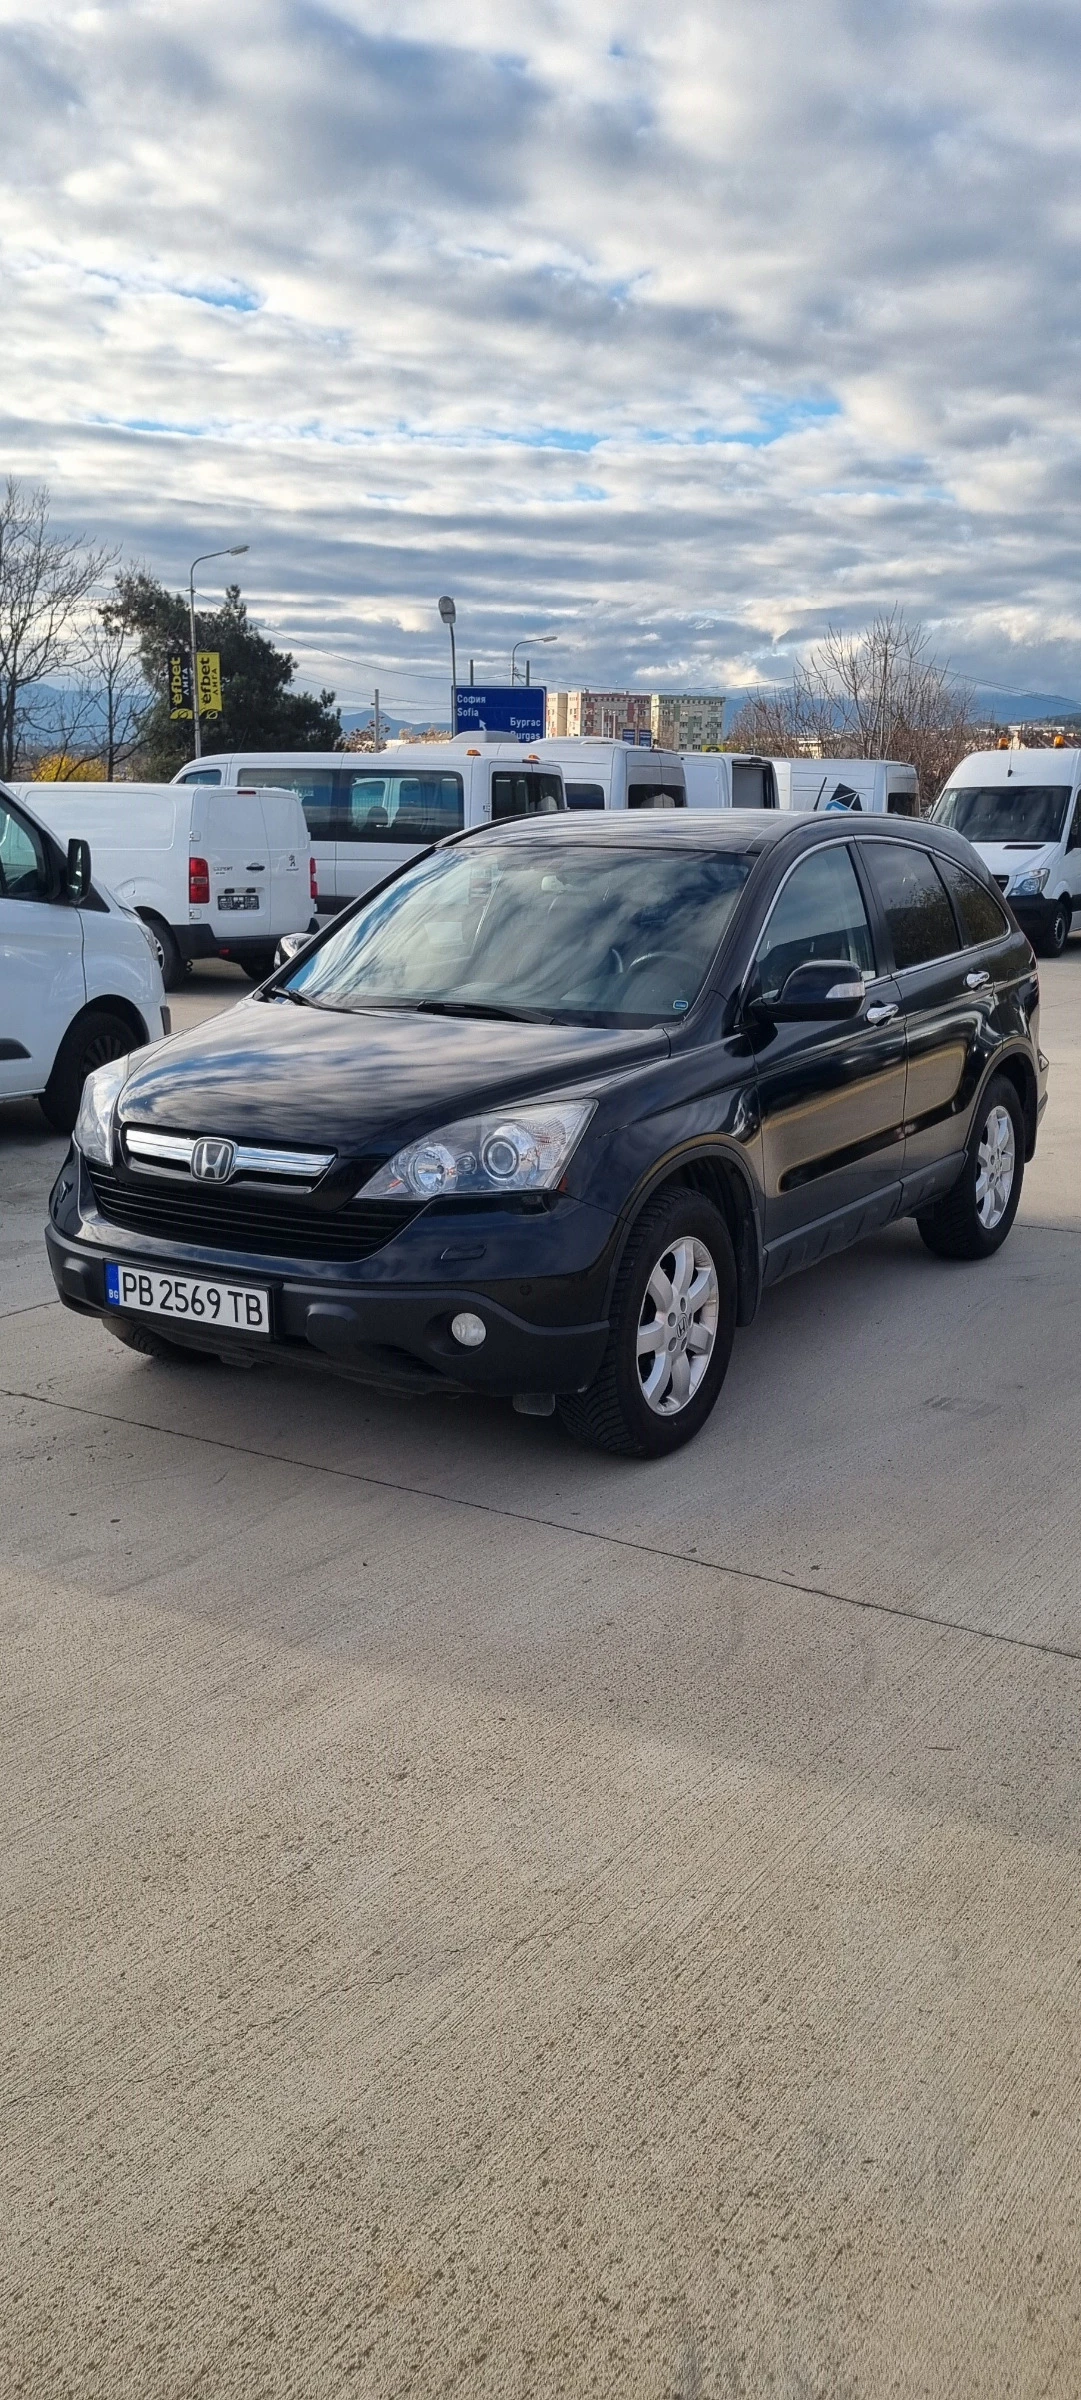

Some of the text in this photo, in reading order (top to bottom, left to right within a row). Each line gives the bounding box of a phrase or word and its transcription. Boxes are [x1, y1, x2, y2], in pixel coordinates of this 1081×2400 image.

[170, 656, 183, 705] efbet
[199, 656, 212, 705] efbet
[456, 694, 486, 704] София
[457, 707, 479, 717] Sofia
[509, 717, 541, 728] Бургас
[108, 1288, 119, 1300] BG
[122, 1271, 263, 1326] PB 2569 TB
